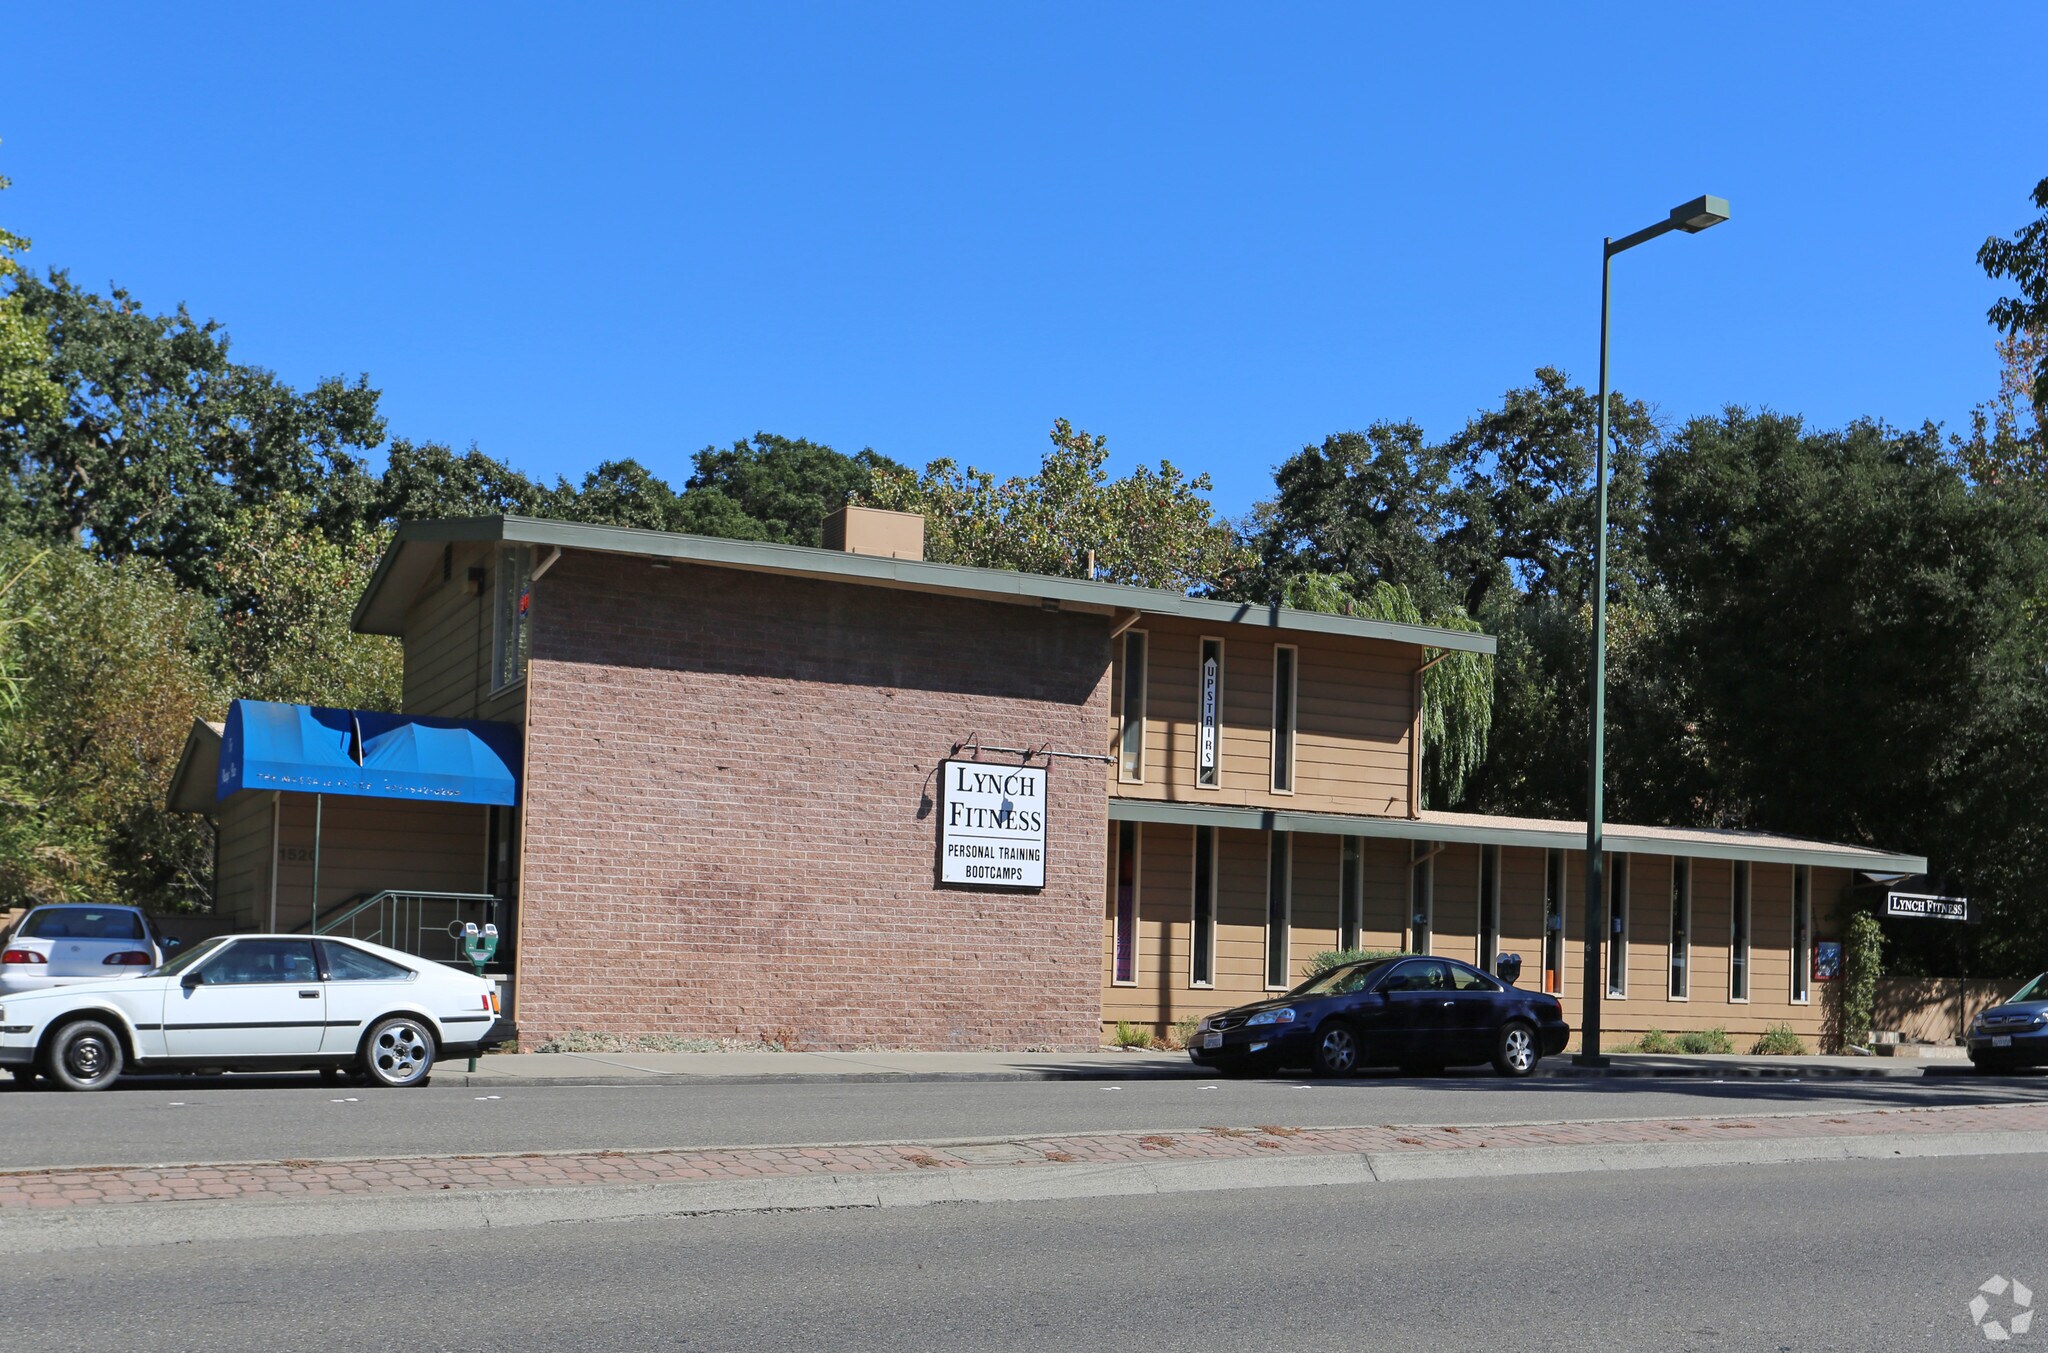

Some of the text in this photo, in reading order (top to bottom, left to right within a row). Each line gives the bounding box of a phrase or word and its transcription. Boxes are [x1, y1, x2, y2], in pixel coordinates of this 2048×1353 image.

[1205, 667, 1214, 762] UPSTAIRS
[957, 767, 1035, 797] LYNCH
[949, 801, 1041, 832] FITNESS
[948, 844, 1040, 861] PERSONAL TRAINING
[965, 865, 1022, 880] BOOTCAMPS
[1892, 897, 1963, 915] LYNCH FITNESS
